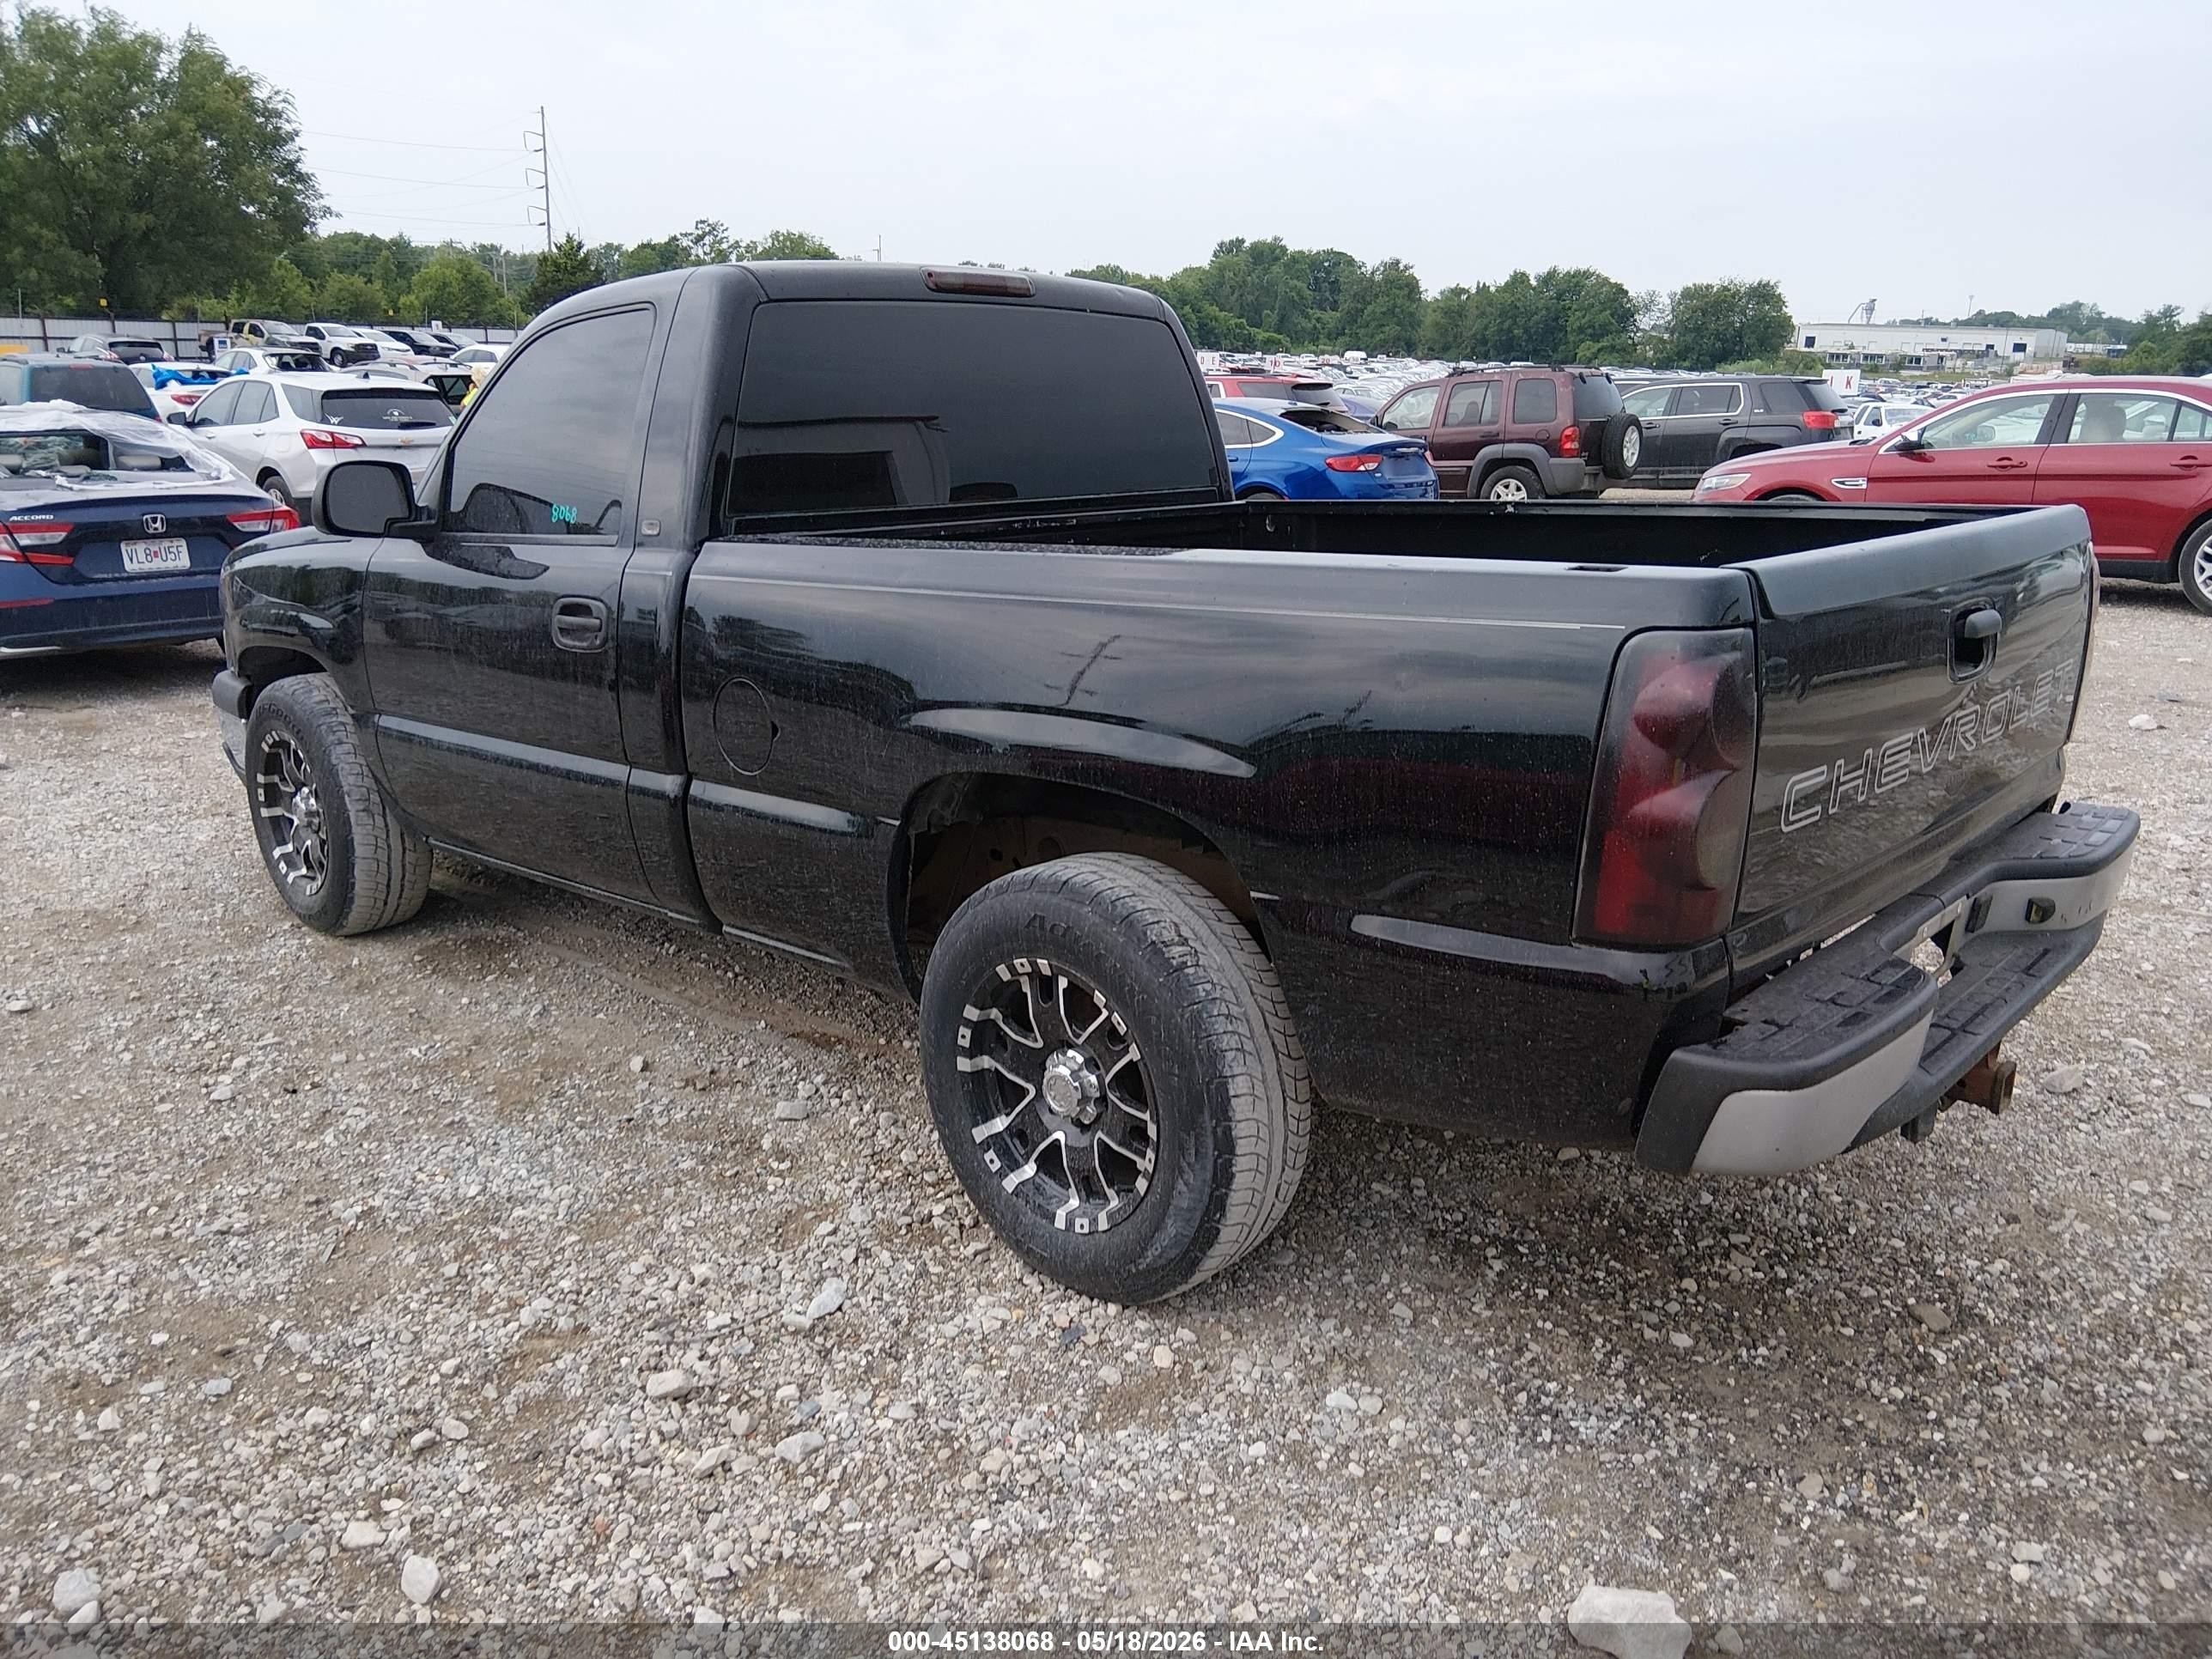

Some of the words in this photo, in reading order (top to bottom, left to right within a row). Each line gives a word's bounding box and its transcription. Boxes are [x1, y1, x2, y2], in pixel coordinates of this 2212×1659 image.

[1845, 376, 1853, 389] K
[551, 504, 578, 524] 8068
[1780, 658, 2074, 833] CHEVROLET
